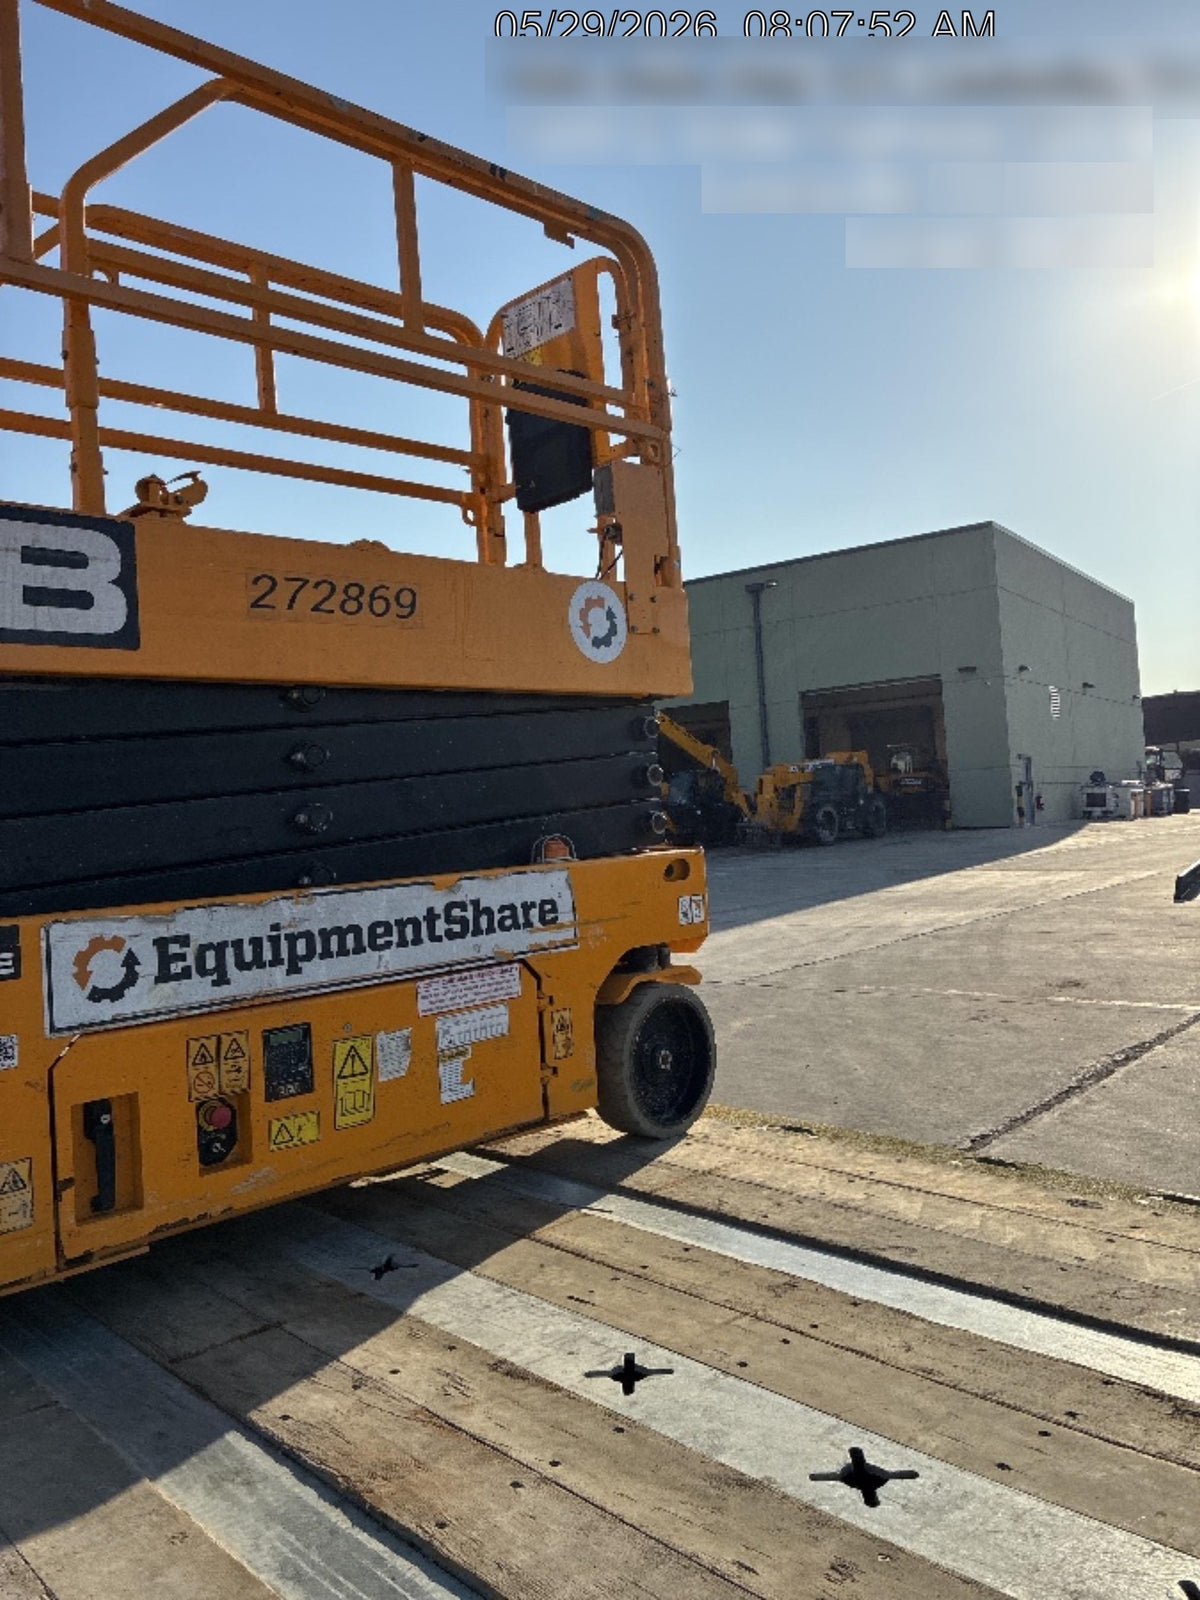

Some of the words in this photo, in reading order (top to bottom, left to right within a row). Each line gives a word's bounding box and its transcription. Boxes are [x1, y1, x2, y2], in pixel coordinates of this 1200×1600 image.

[0, 518, 128, 635] B
[250, 573, 418, 619] 272869
[152, 897, 560, 987] EquipmentShare
